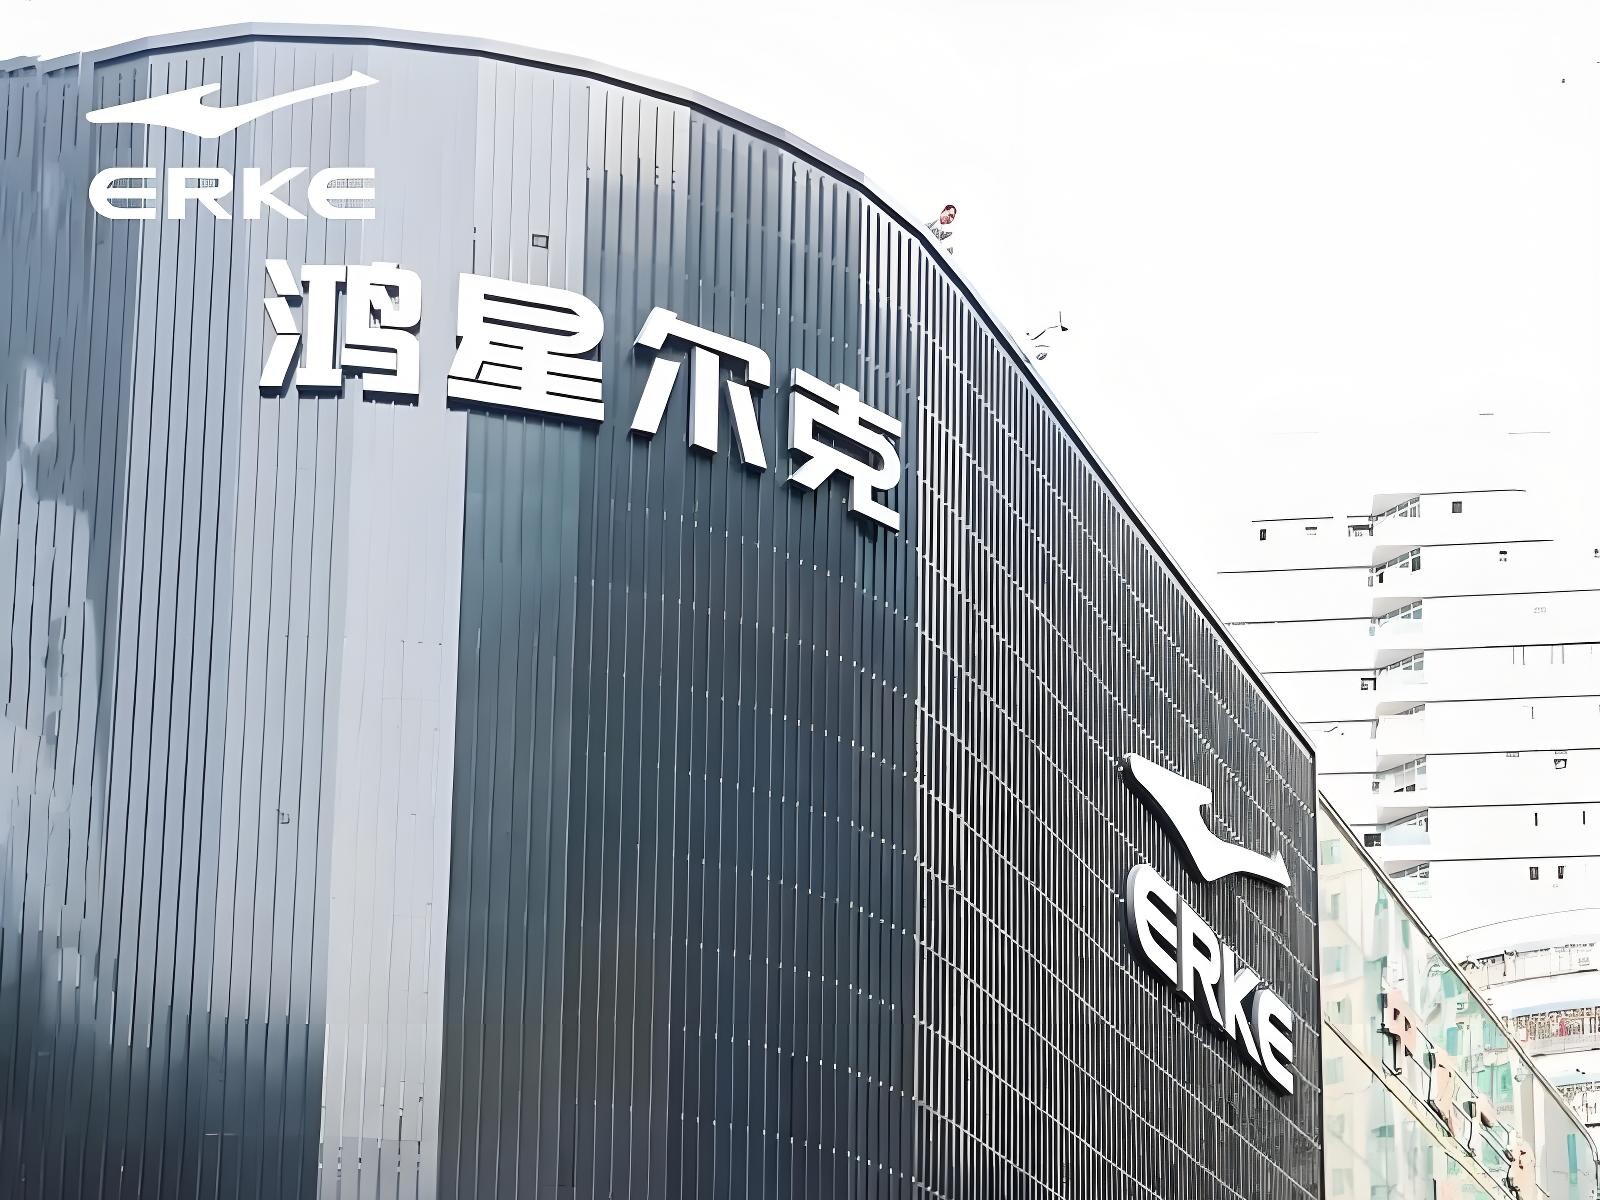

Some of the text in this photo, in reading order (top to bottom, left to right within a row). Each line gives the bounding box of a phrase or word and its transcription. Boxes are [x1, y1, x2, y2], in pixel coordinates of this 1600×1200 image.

[259, 259, 901, 533] 鸿星尔克
[1125, 863, 1294, 1095] ERKE
